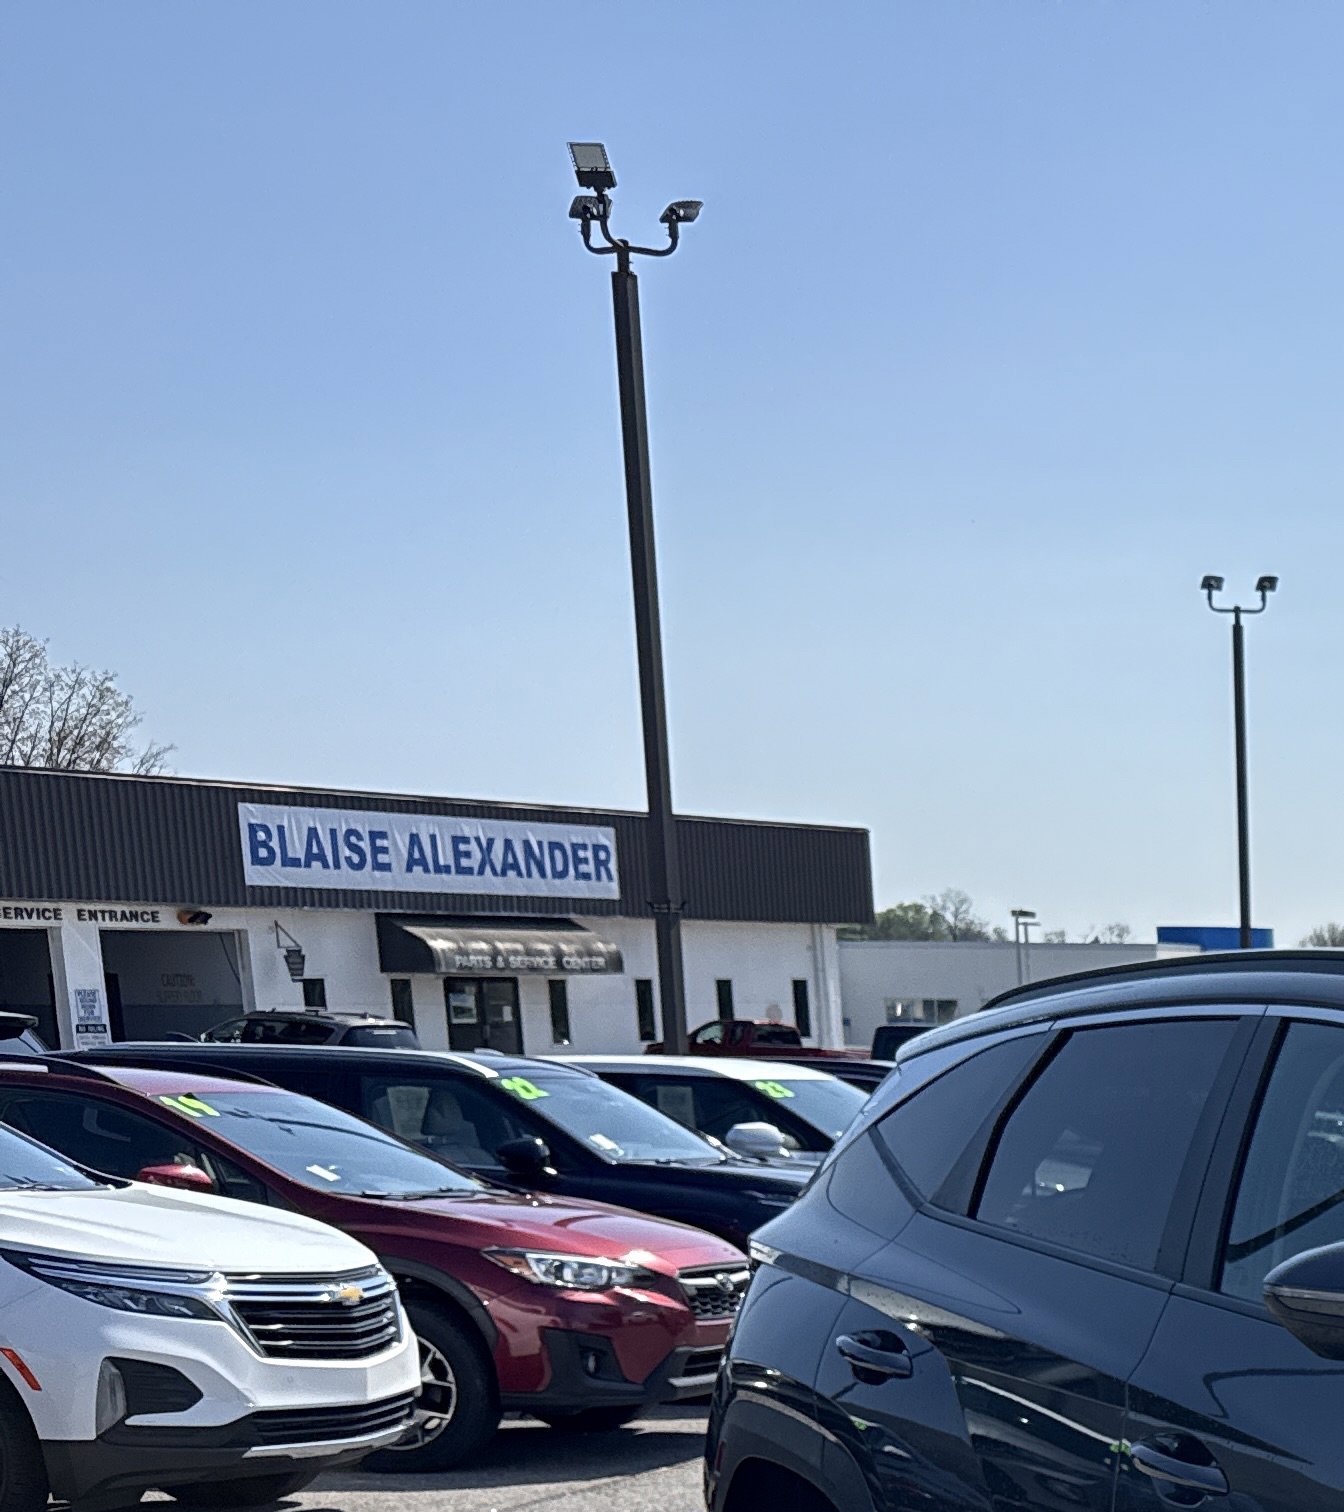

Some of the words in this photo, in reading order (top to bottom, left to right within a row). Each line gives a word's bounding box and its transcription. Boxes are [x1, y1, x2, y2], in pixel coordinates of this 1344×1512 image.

[247, 822, 393, 873] BLAISE
[404, 831, 614, 884] ALEXANDER
[0, 905, 64, 921] ERVICE
[76, 908, 162, 924] ENTRANCE
